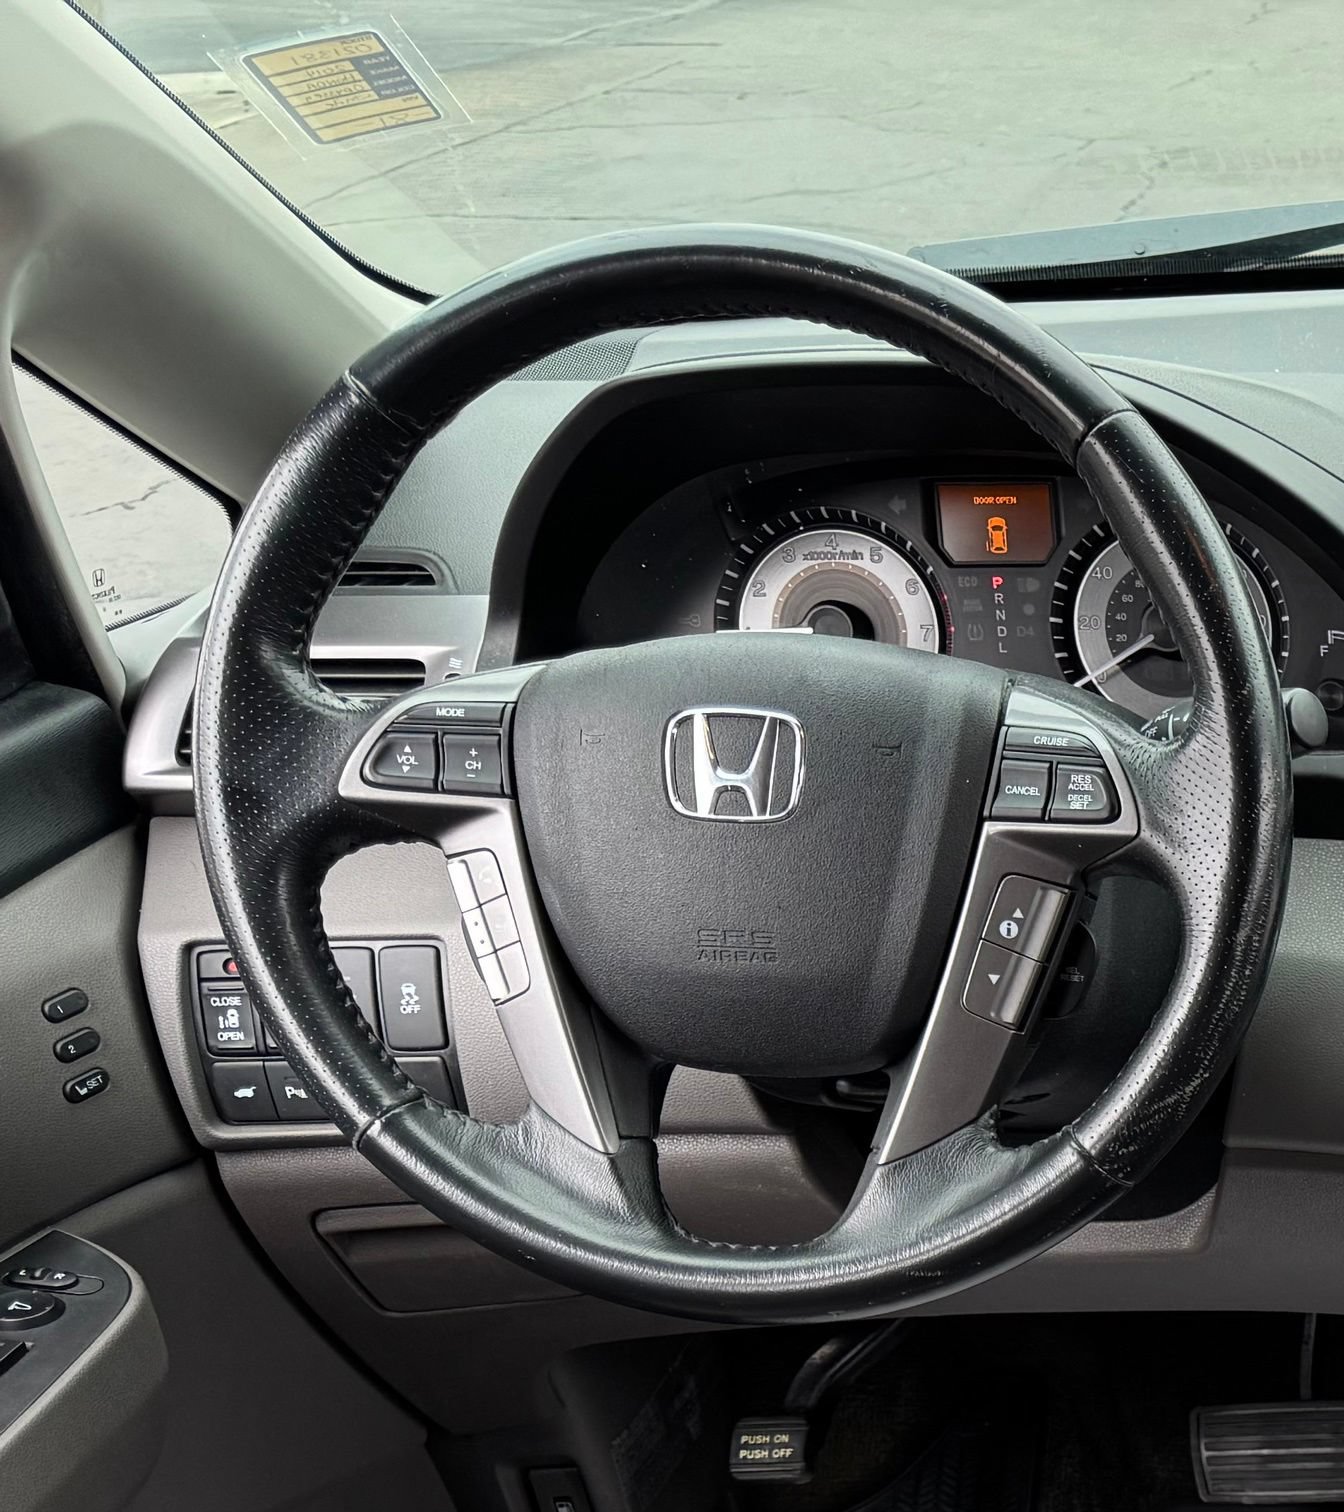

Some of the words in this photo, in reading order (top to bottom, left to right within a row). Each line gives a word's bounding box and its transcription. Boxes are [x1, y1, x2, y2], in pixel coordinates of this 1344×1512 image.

[973, 496, 994, 504] DOOR
[996, 496, 1017, 504] OPEN
[825, 533, 839, 550] 4
[782, 547, 796, 564] 3
[802, 549, 864, 561] x1000r/min
[870, 546, 884, 564] 5
[1092, 566, 1112, 580] 40
[904, 578, 920, 595] 6
[958, 576, 978, 588] ECO
[992, 576, 1004, 588] P
[752, 580, 766, 597] 2
[994, 593, 1004, 604] R
[1121, 594, 1134, 603] 60
[996, 610, 1006, 621] N
[1114, 612, 1127, 621] 40
[1078, 616, 1100, 630] 20
[920, 624, 934, 642] 7
[998, 626, 1008, 638] D
[1115, 634, 1128, 642] 20
[998, 642, 1008, 653] L
[1320, 645, 1328, 656] F
[436, 706, 465, 718] MODE
[1033, 736, 1070, 747] CRUISE
[396, 754, 418, 765] VOL
[465, 760, 482, 770] CH
[1070, 774, 1092, 784] RES
[1004, 785, 1040, 796] CANCEL
[1068, 782, 1095, 792] ACCEL
[1068, 794, 1093, 802] DECEL
[1070, 801, 1088, 810] SET
[210, 996, 242, 1007] CLOSE
[56, 1004, 64, 1014] 1
[400, 1006, 421, 1014] OFF
[217, 1032, 245, 1041] OPEN
[68, 1044, 76, 1054] 2
[86, 1074, 104, 1089] SET
[740, 1434, 770, 1444] PUSH
[773, 1434, 790, 1444] ON
[739, 1449, 769, 1459] PUSH
[772, 1448, 794, 1458] OFF
